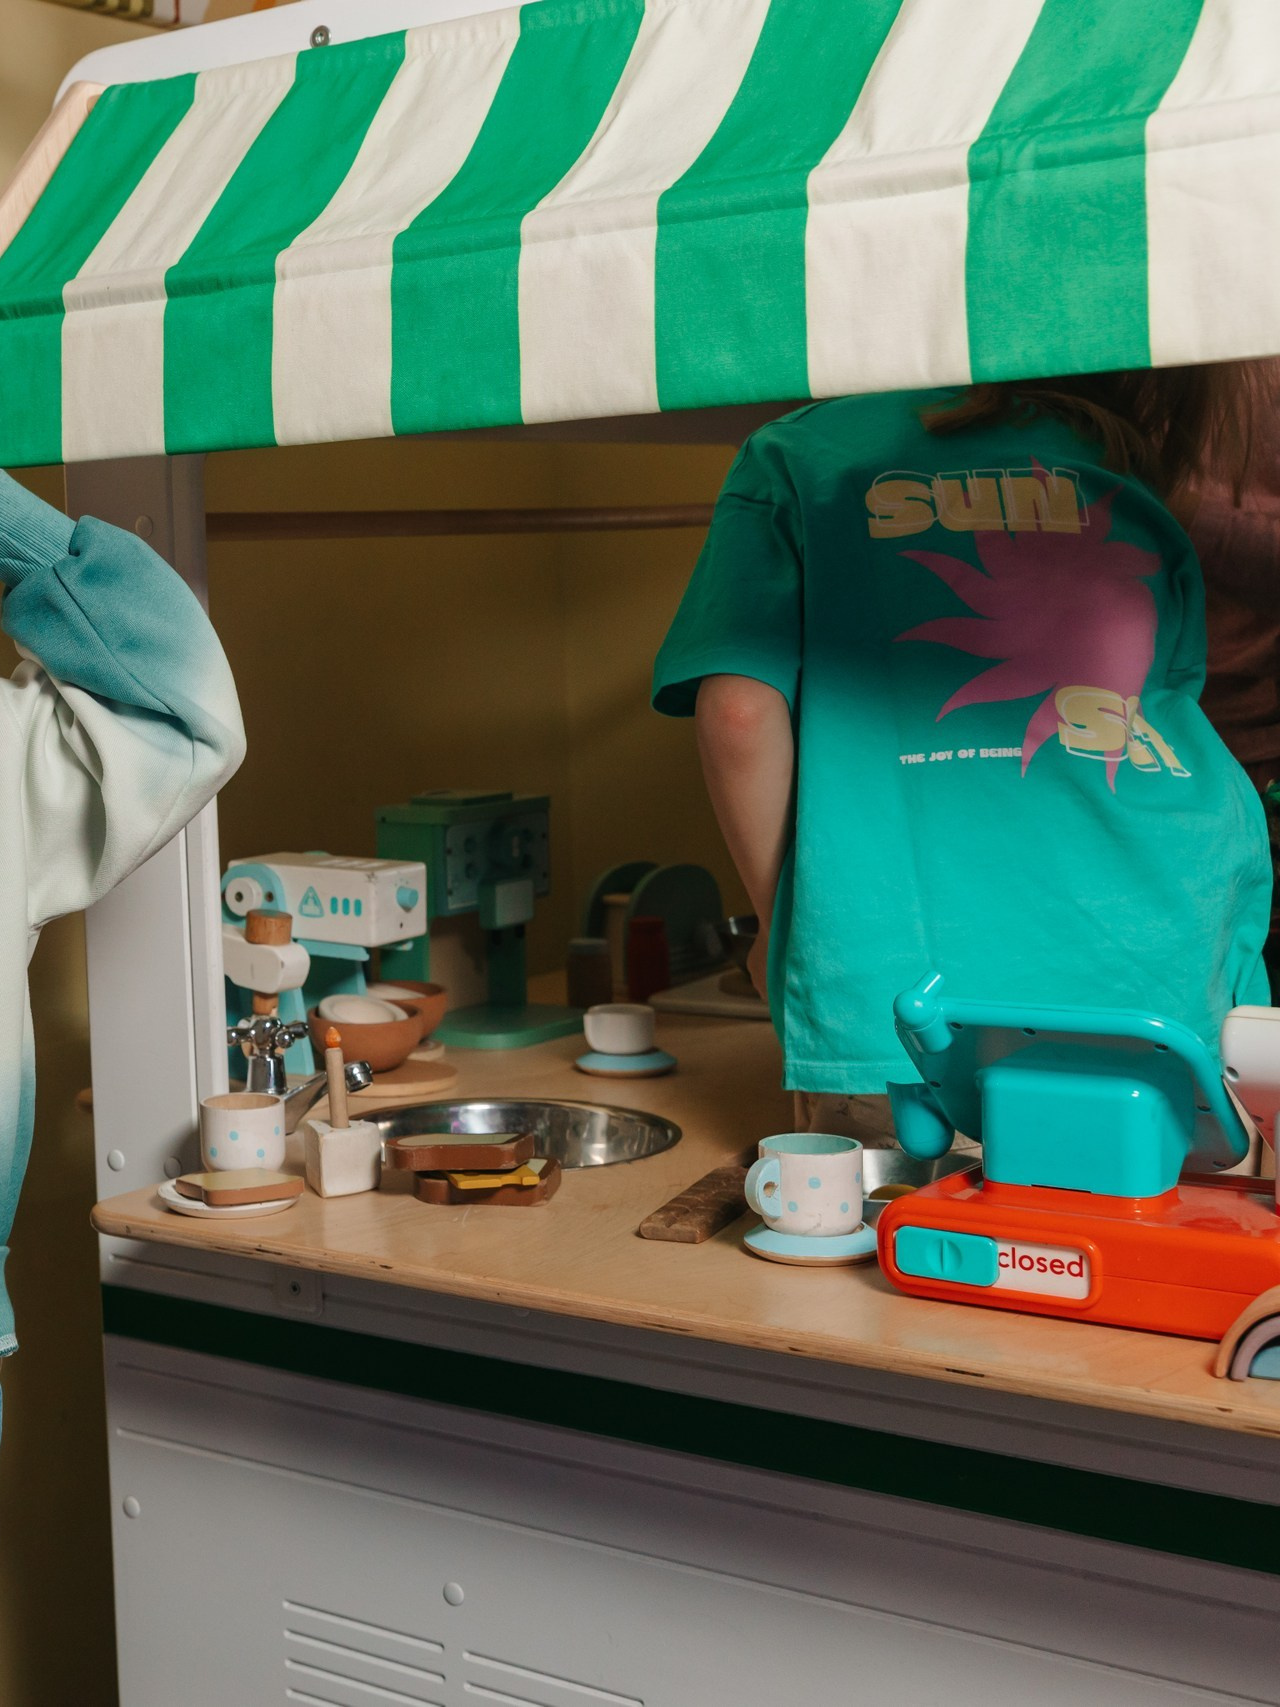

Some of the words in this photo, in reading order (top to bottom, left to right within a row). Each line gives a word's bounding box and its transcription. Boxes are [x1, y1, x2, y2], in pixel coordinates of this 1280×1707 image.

[900, 754, 925, 764] THE
[929, 750, 953, 762] JOY
[957, 749, 975, 758] OF
[980, 747, 1022, 758] BEING
[998, 1247, 1084, 1278] closed
